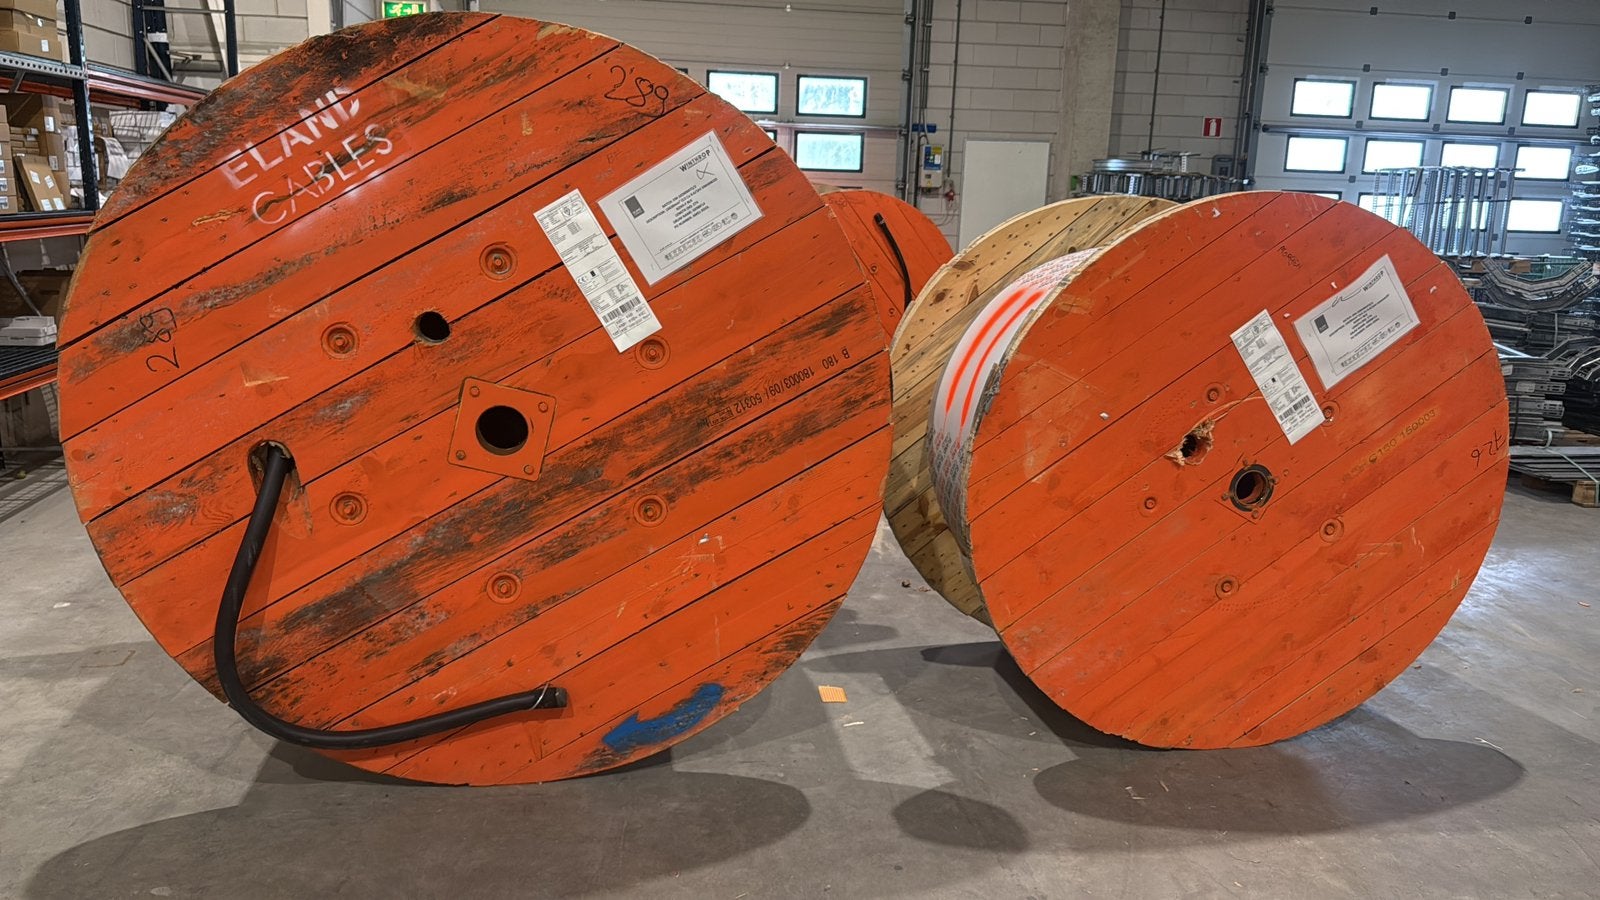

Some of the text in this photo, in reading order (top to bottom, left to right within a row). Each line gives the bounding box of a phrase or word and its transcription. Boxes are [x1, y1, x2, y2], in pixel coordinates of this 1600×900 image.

[221, 87, 360, 190] ELAND
[679, 149, 711, 172] WINTHROP
[253, 124, 393, 224] CABLES
[821, 353, 839, 369] 180
[841, 346, 850, 359] B
[735, 393, 763, 414] 50312
